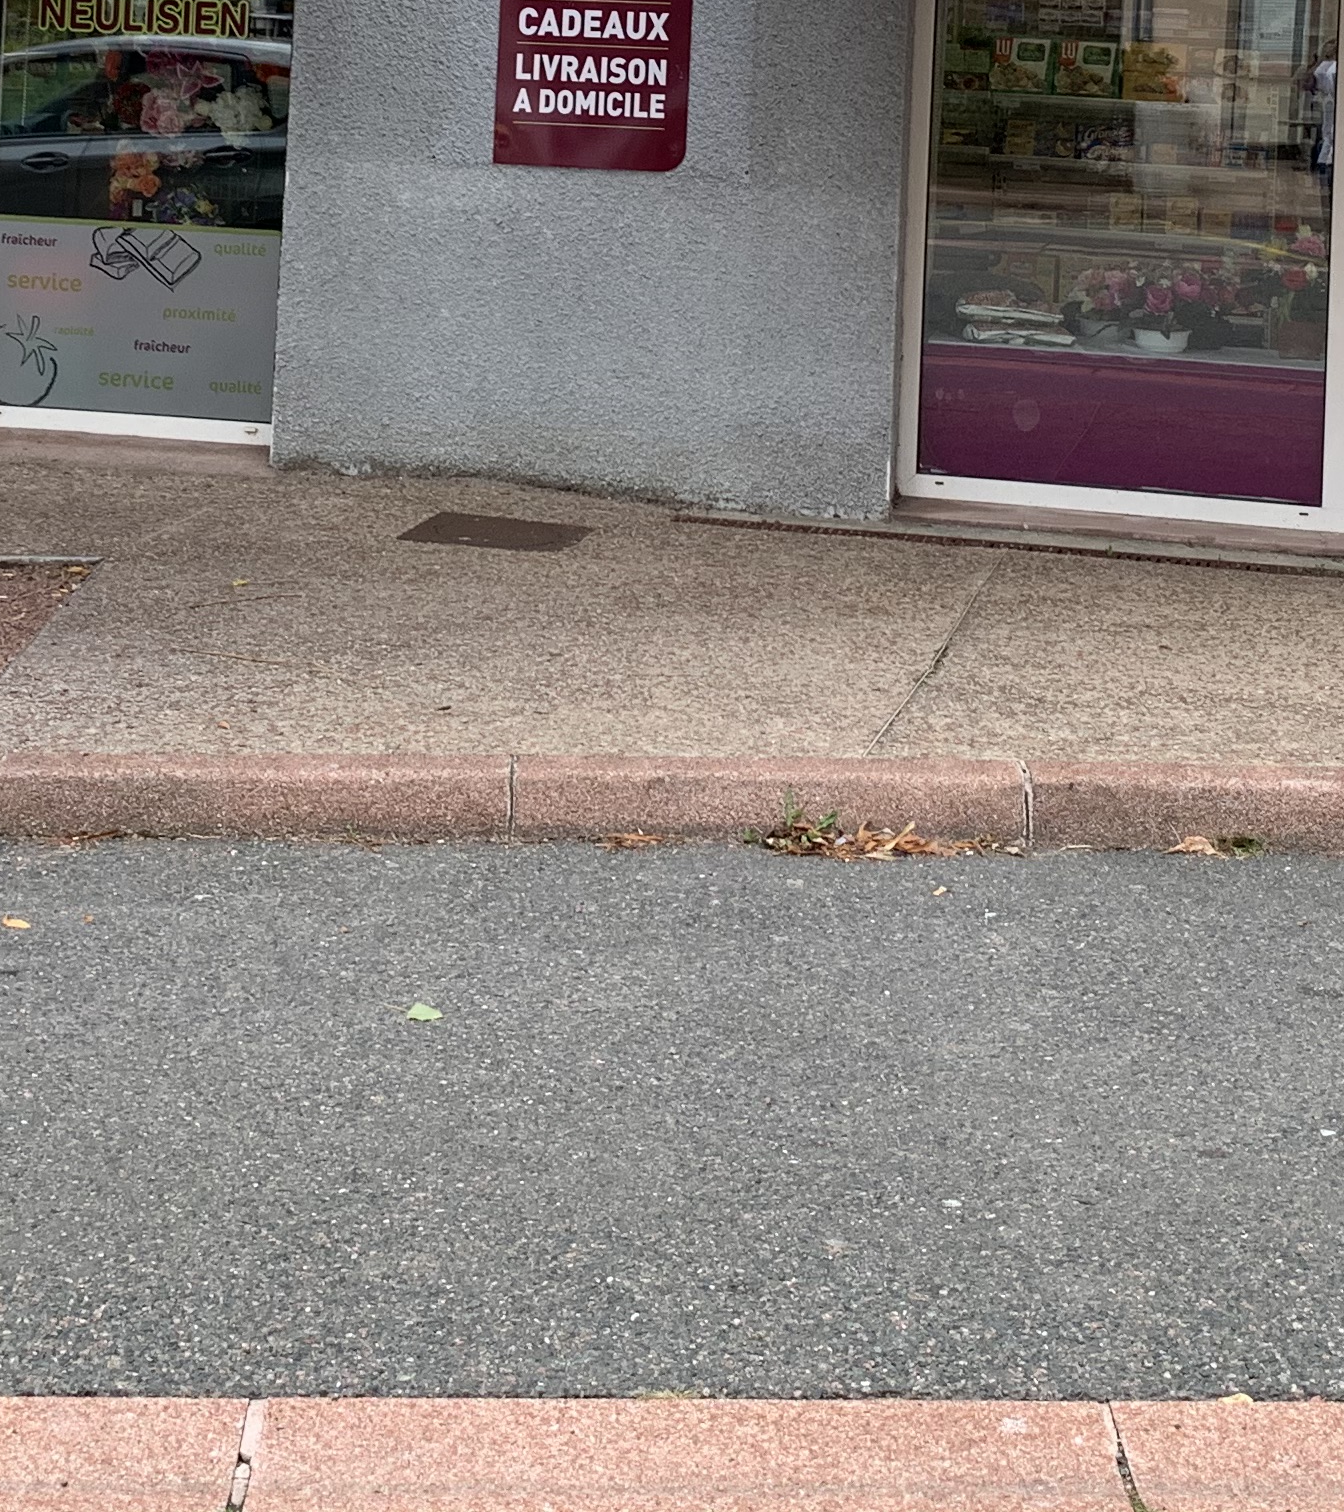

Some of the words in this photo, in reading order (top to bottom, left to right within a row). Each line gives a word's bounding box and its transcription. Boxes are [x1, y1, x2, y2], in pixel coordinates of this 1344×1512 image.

[518, 7, 669, 41] CADEAUX
[996, 39, 1010, 55] LU
[1061, 42, 1076, 58] LU
[514, 52, 668, 86] LIVRAISON
[512, 87, 532, 114] A
[538, 88, 665, 119] DOMICILE
[1, 233, 58, 248] fraîcheur
[213, 242, 267, 257] qualité
[7, 272, 82, 292] service
[163, 306, 237, 322] proximité
[134, 339, 191, 354] fraîcheur
[98, 370, 175, 390] service
[209, 380, 262, 396] qualité
